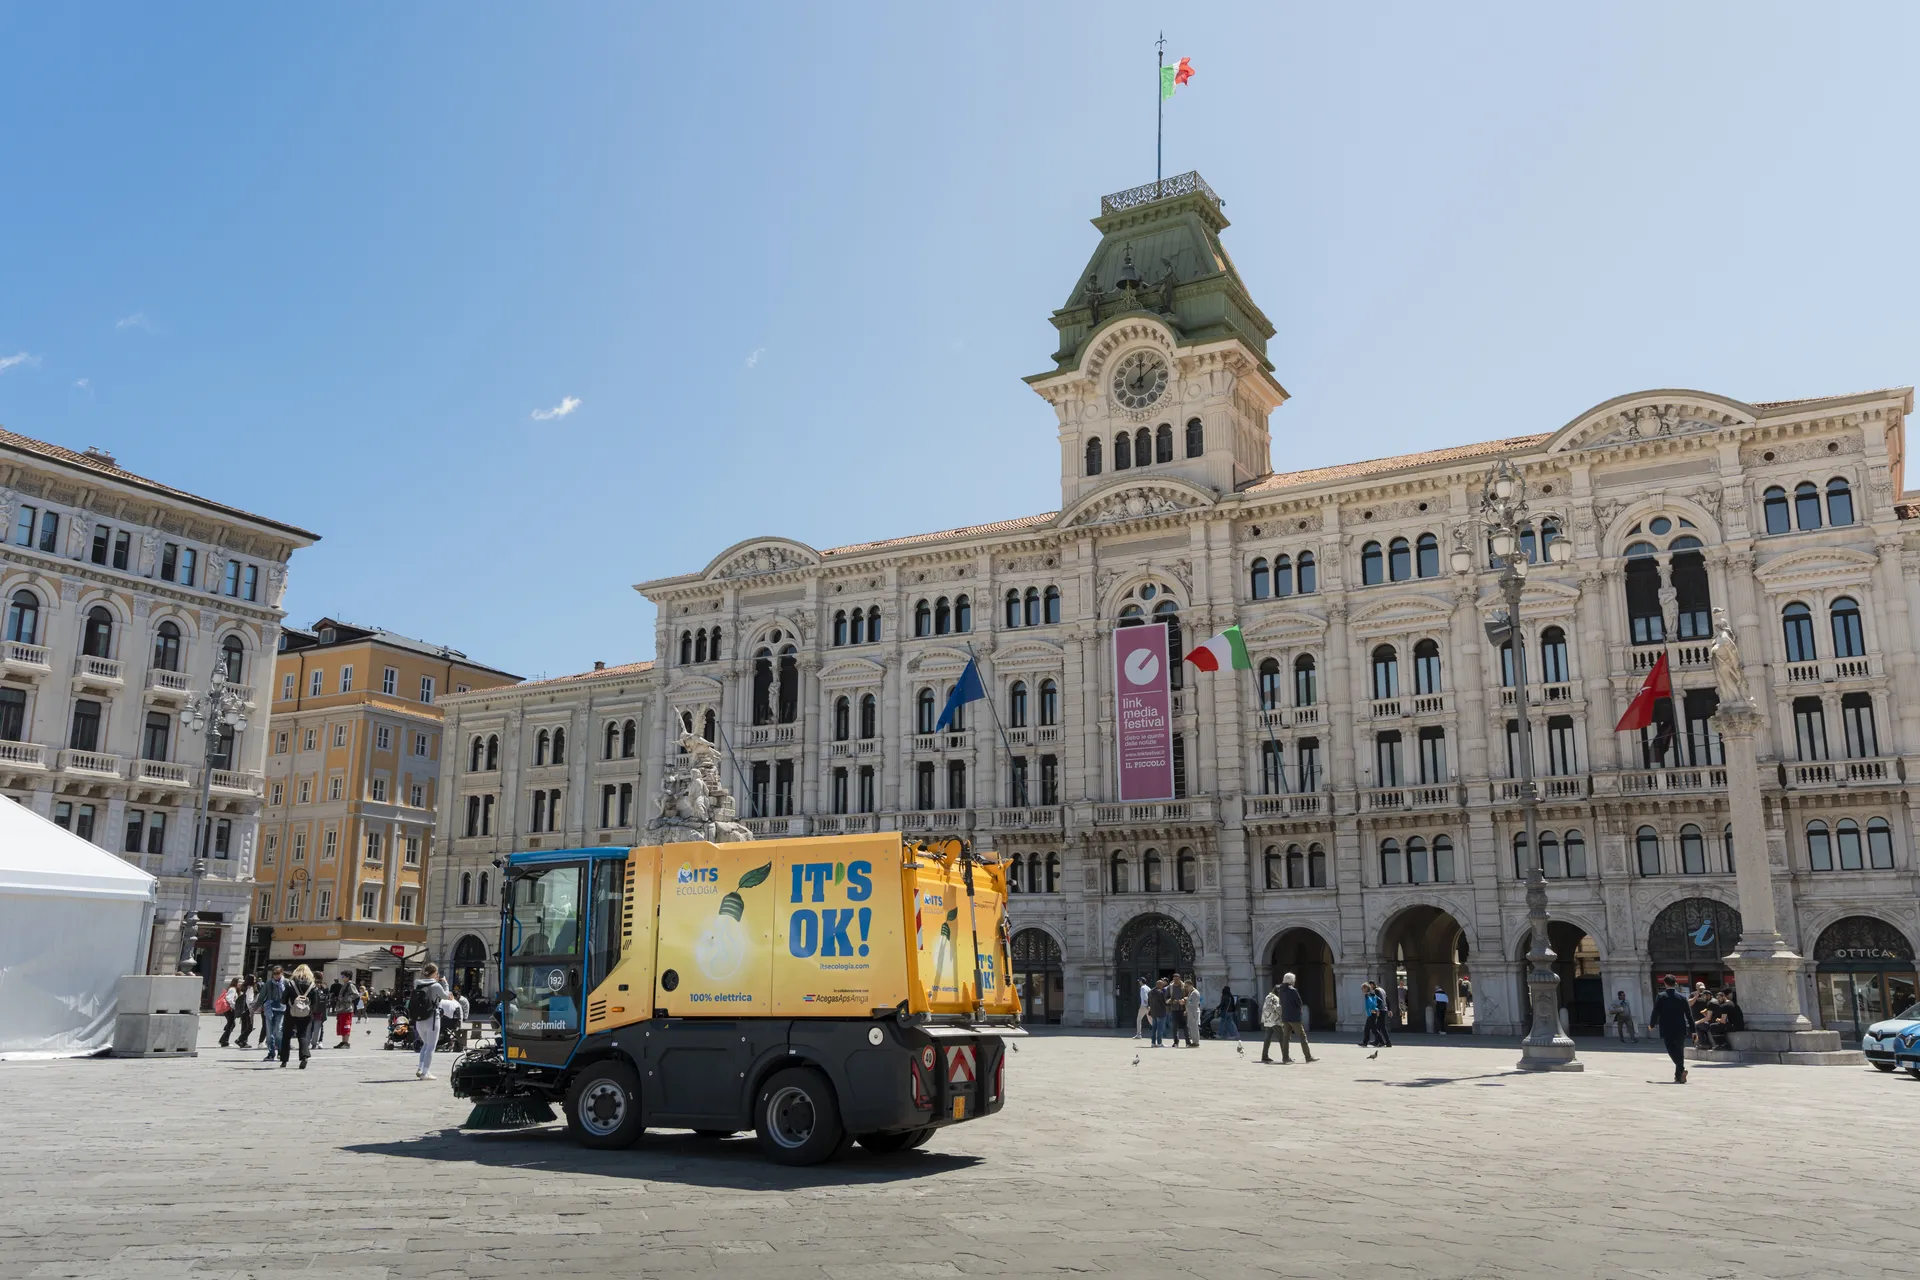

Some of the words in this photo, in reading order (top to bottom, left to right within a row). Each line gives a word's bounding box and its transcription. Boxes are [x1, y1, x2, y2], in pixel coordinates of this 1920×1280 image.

[1122, 697, 1143, 709] link
[1123, 706, 1158, 719] media
[1124, 716, 1164, 729] festival
[1134, 760, 1166, 768] PICCOLO
[693, 867, 719, 883] ITS
[790, 860, 873, 904] IT'S
[676, 886, 718, 896] ECOLOGIA
[931, 895, 943, 907] ITS
[789, 906, 873, 959] OK!
[1837, 948, 1892, 958] OTTICA
[820, 963, 870, 971] itsecologia.com
[978, 953, 994, 970] T'S
[550, 976, 562, 985] 192
[690, 993, 712, 1002] 100%
[714, 992, 753, 1002] elettrica
[816, 994, 869, 1005] AcegasApsAmga
[531, 1020, 566, 1030] schmidt
